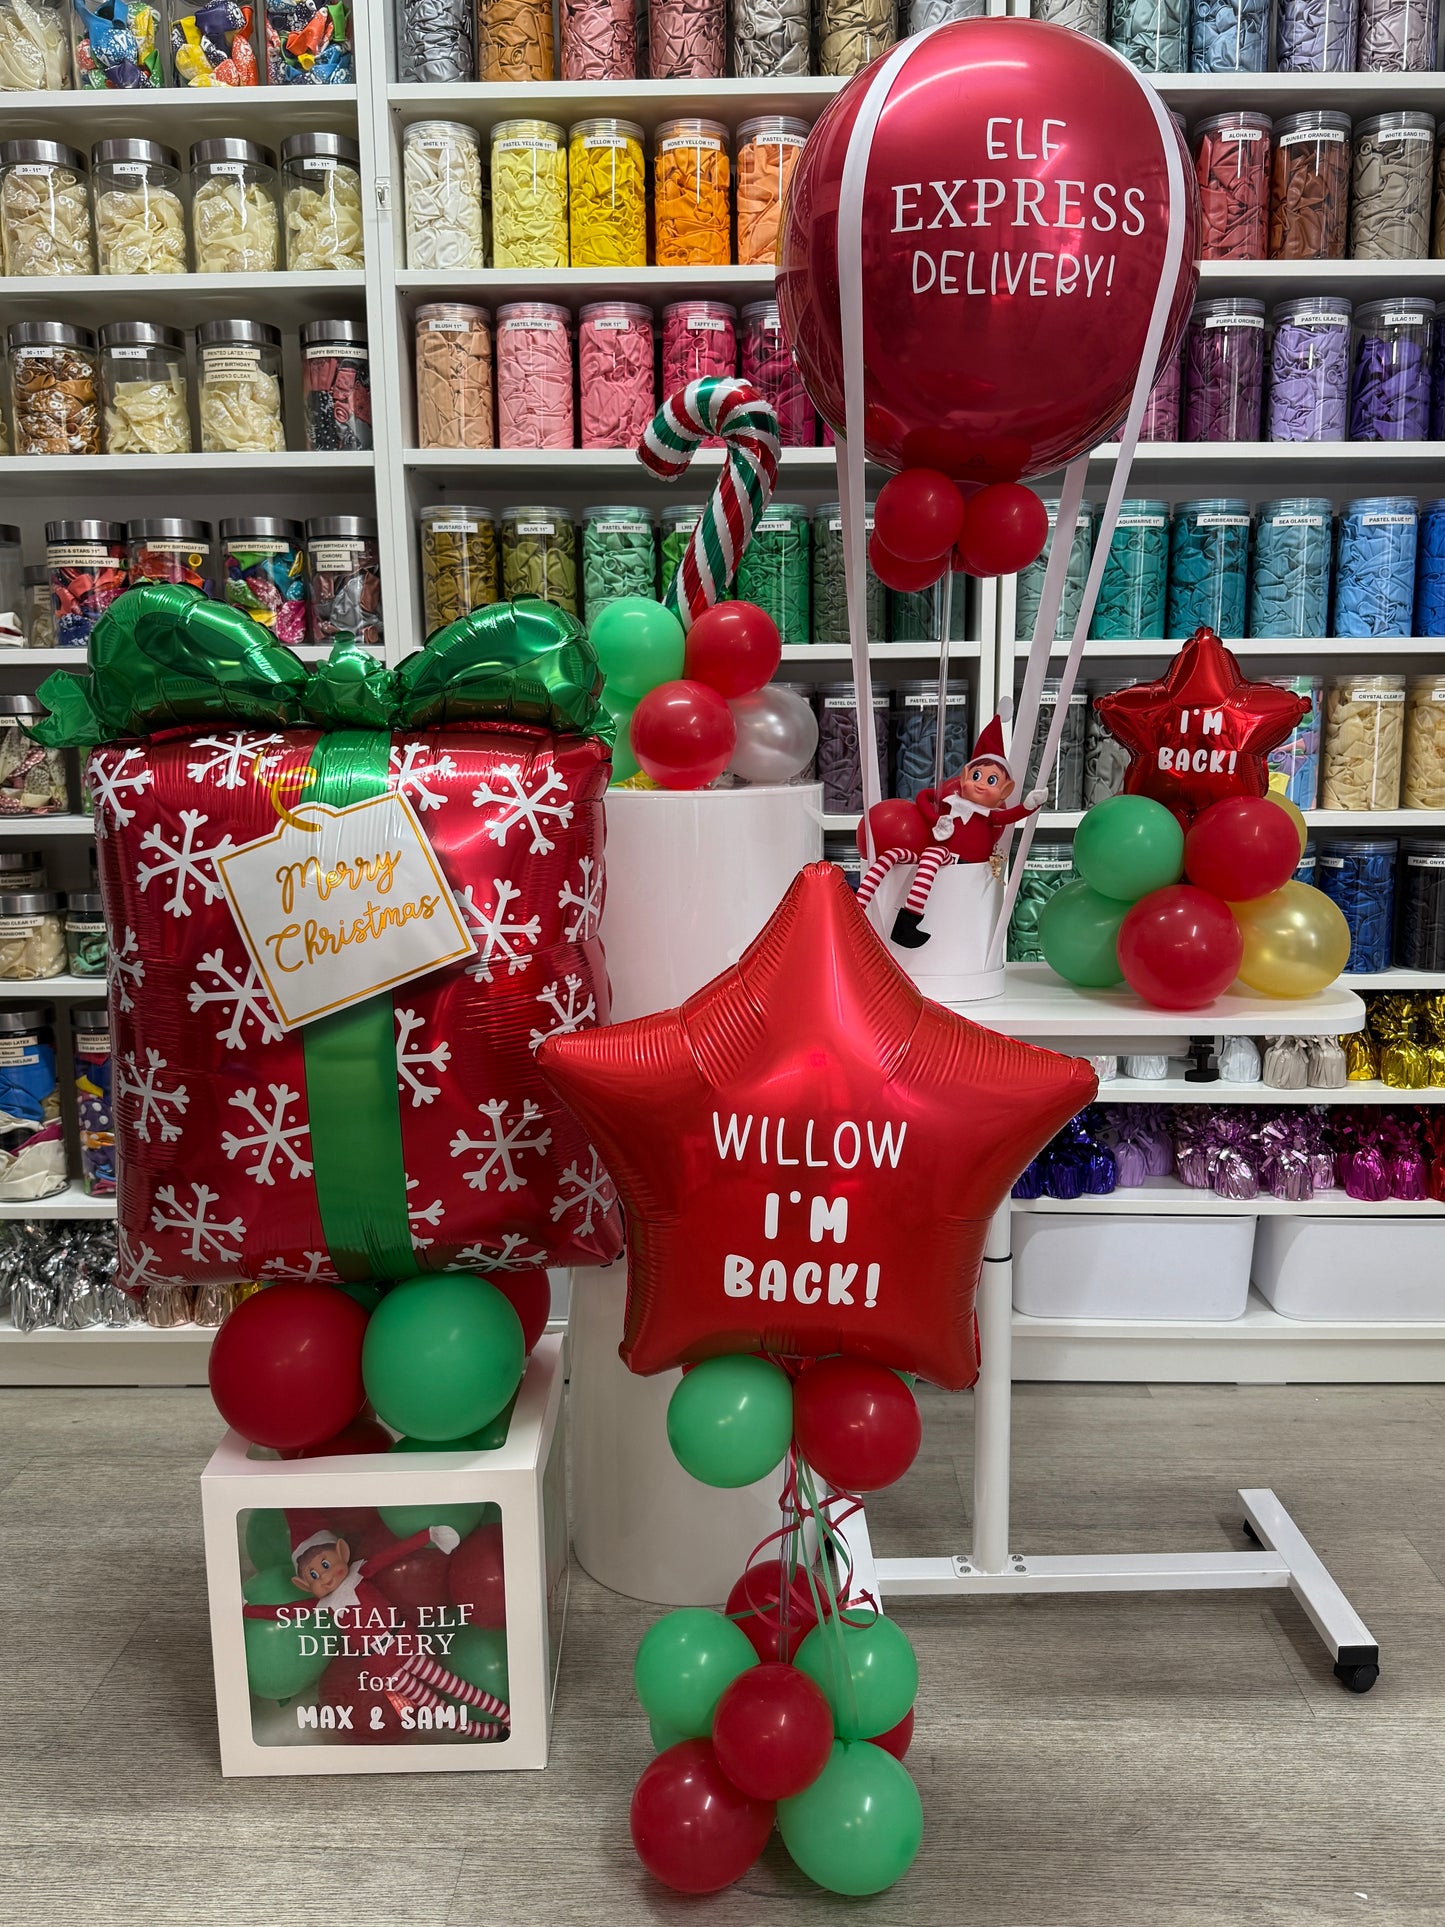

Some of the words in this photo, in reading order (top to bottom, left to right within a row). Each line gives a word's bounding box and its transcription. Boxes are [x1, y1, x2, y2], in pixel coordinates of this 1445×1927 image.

[986, 117, 1066, 161] ELF
[1285, 135, 1307, 143] SUNSET
[890, 178, 1145, 236] EXPRESS
[912, 250, 1116, 298] DELIVERY!
[1180, 708, 1223, 736] I'M
[1158, 746, 1237, 775] BACK!
[275, 849, 401, 914] Merry
[265, 895, 440, 973] Christmas
[712, 1111, 908, 1169] WILLOW
[764, 1190, 848, 1244] I'M
[724, 1253, 881, 1308] BACK!
[275, 1606, 406, 1630] SPECIAL
[416, 1603, 475, 1628] ELF
[298, 1633, 456, 1657] DELIVERY
[357, 1671, 399, 1691] for
[296, 1705, 354, 1730] MAX
[369, 1705, 386, 1730] &
[400, 1704, 468, 1730] SAM!
